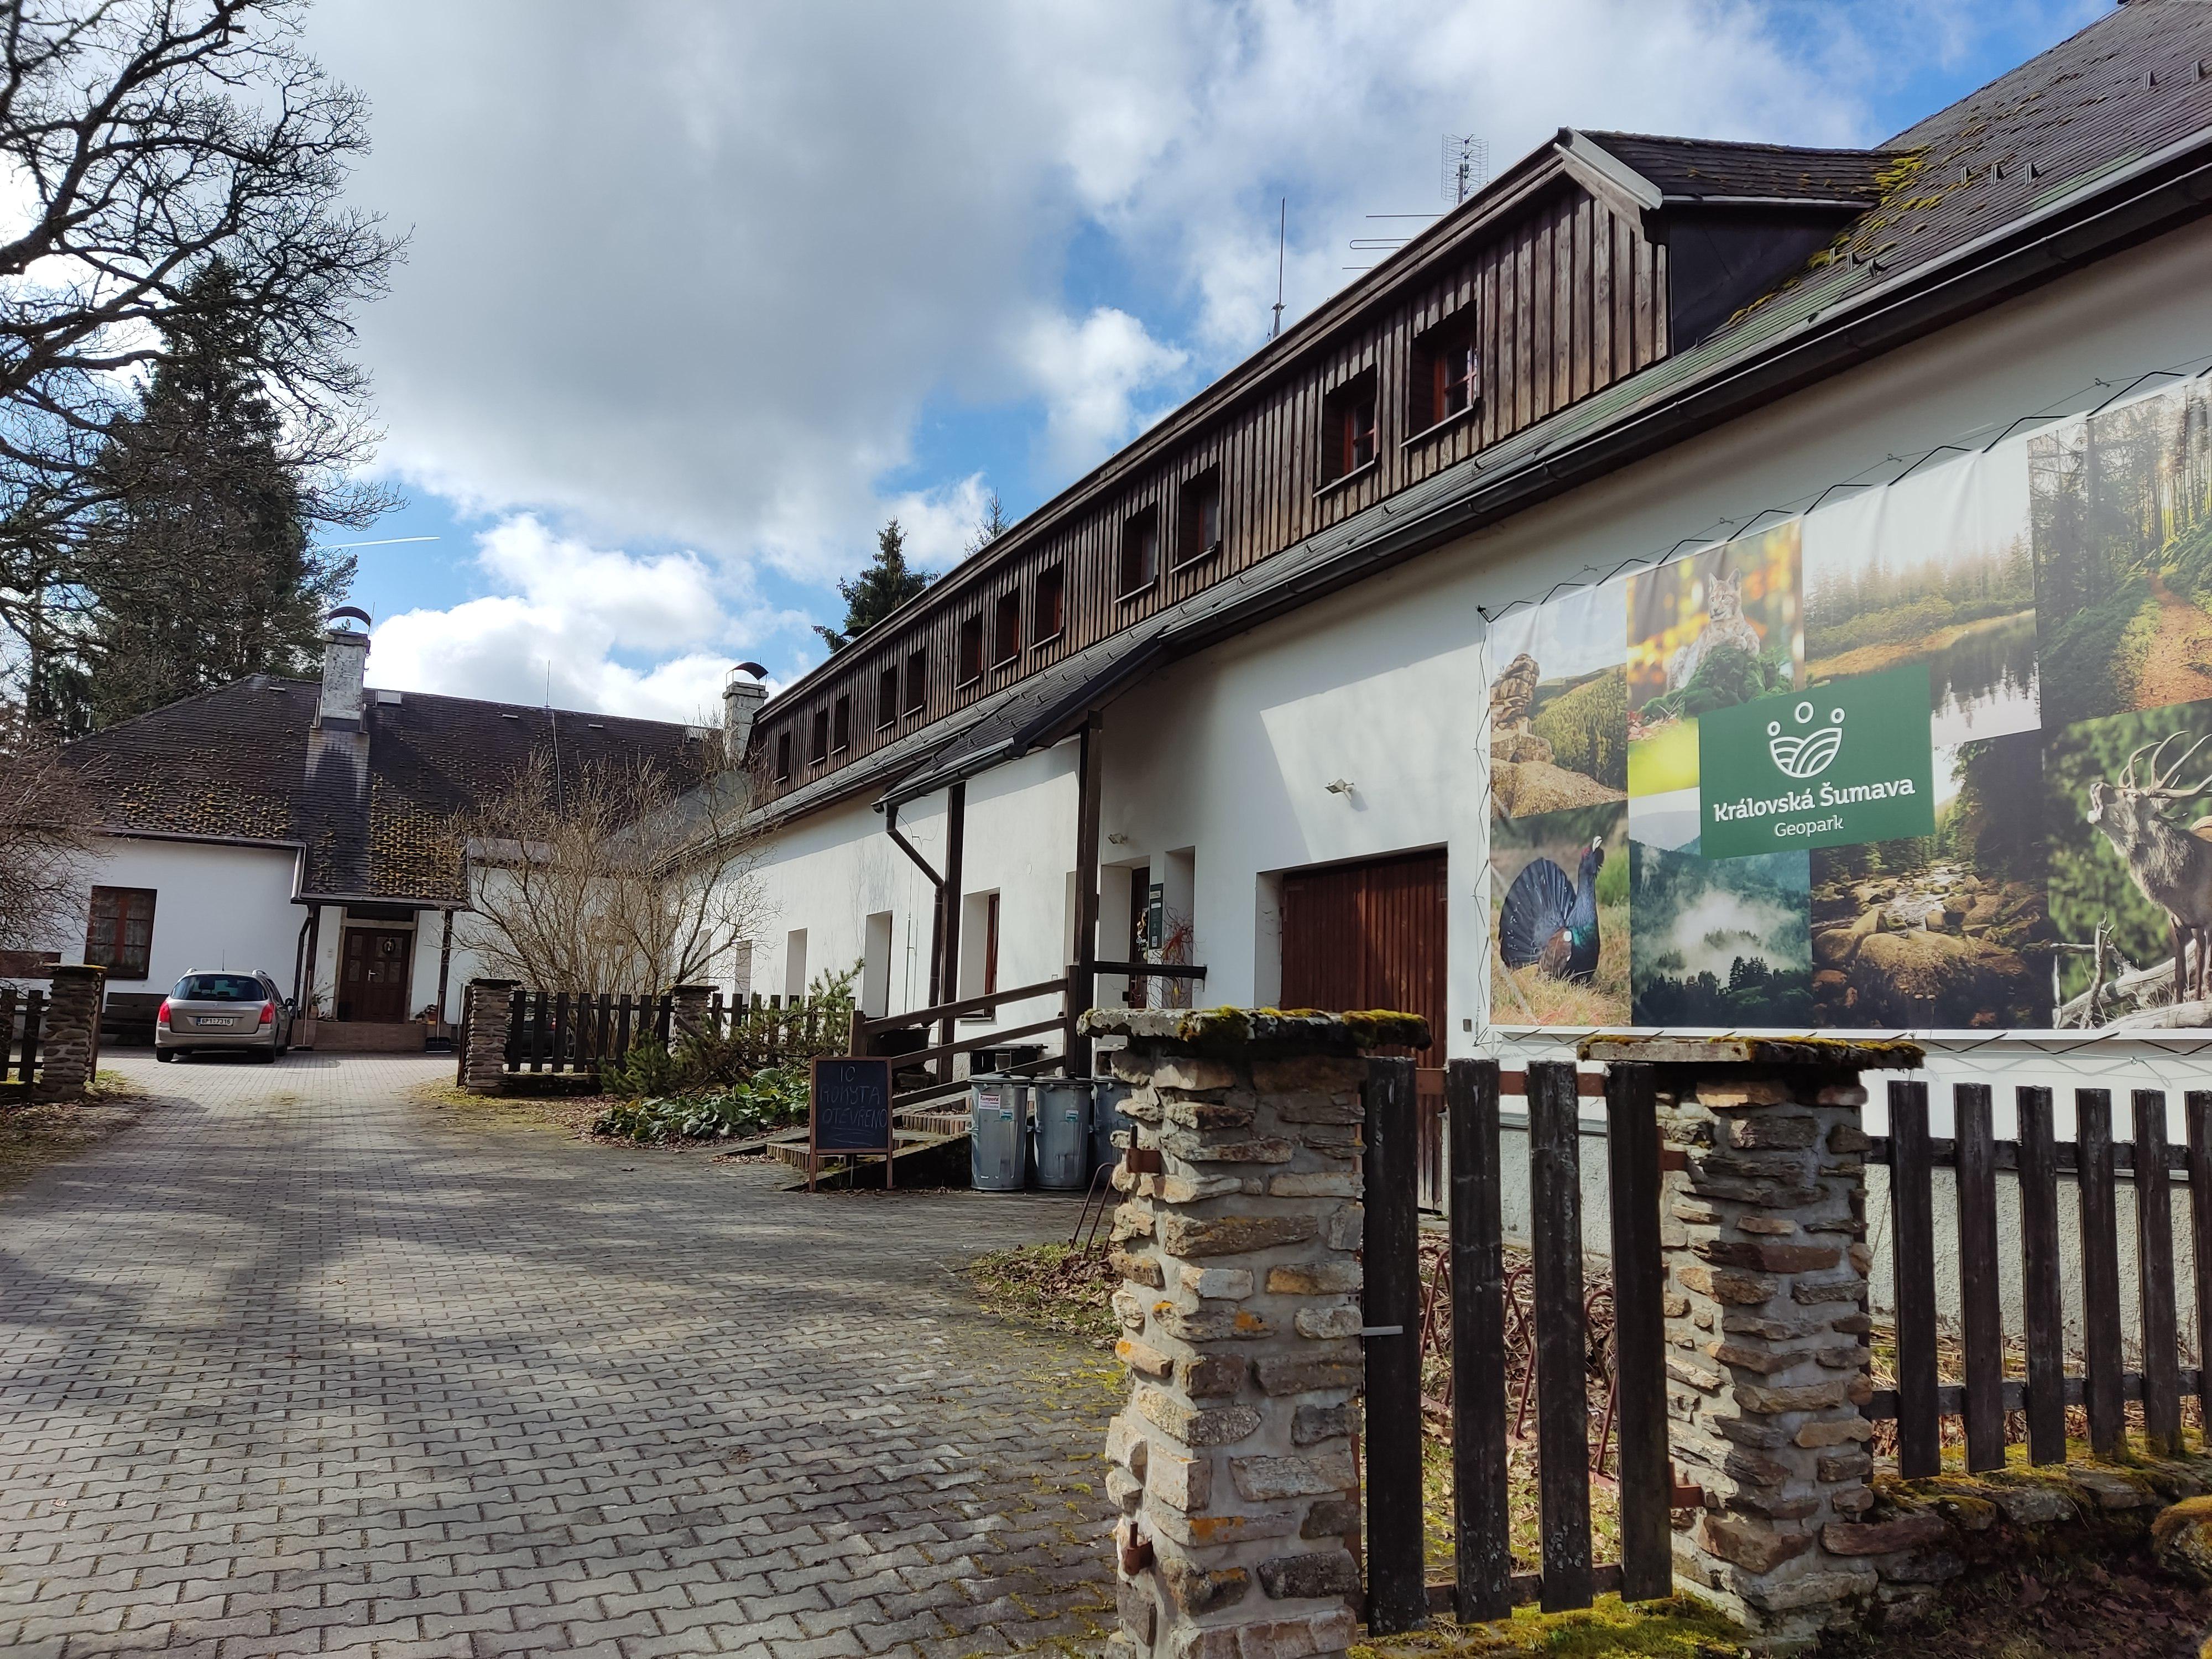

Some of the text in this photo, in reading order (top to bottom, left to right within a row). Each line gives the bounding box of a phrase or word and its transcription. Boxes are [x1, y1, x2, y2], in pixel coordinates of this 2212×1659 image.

[1713, 778, 1916, 822] Královská Šumava
[1774, 815, 1844, 837] Geopark
[841, 1066, 855, 1082] IC
